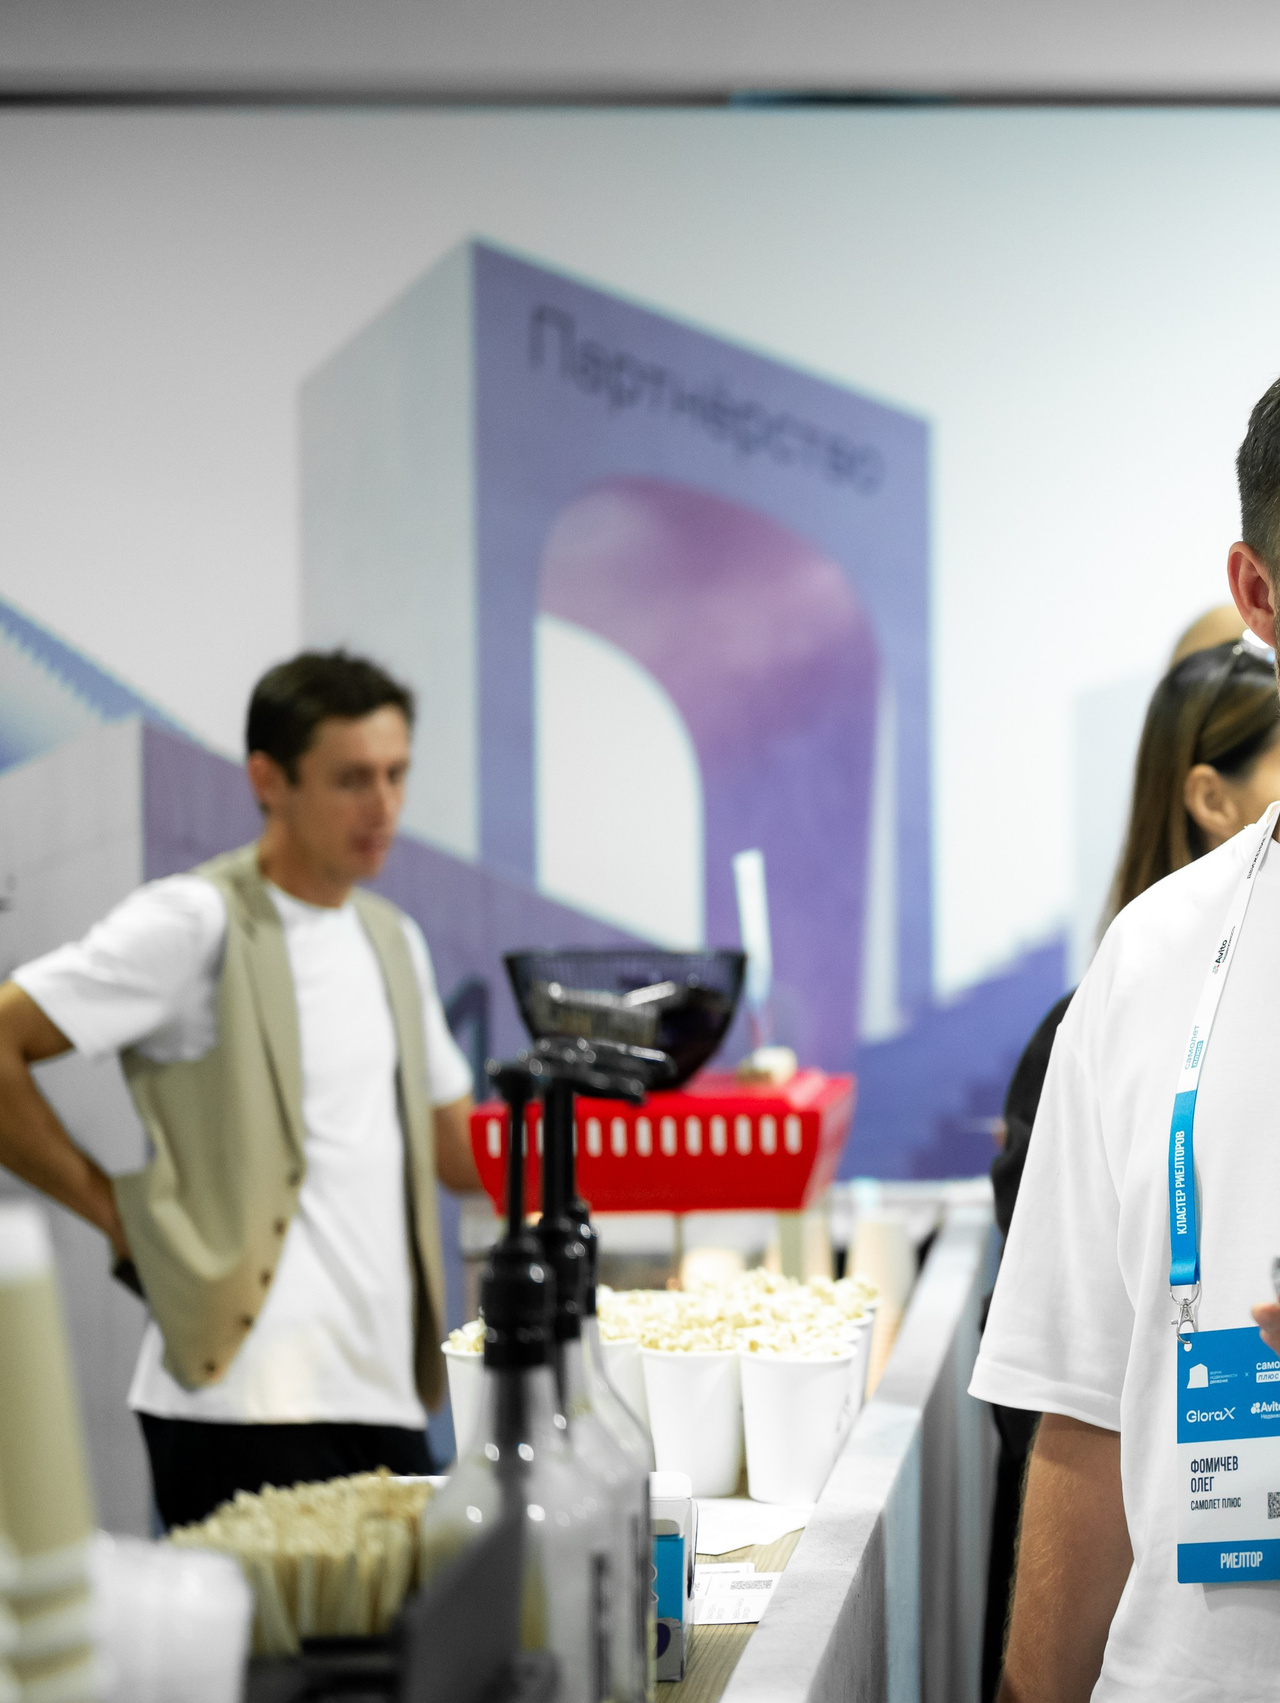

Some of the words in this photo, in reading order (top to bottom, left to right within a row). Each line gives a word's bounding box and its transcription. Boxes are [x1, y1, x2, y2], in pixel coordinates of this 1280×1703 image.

[1215, 939, 1228, 964] Avito
[1175, 1130, 1186, 1188] РИЕЛТОРОВ
[1176, 1189, 1187, 1234] КЛАСТЕР
[1186, 1407, 1236, 1423] GloraX
[1190, 1455, 1239, 1474] ФОМИЧЕВ
[1190, 1476, 1215, 1493] ОЛЕГ
[1190, 1498, 1220, 1511] САМОЛЕТ
[1221, 1497, 1242, 1508] ПЛЮС
[1220, 1551, 1263, 1569] РИЕЛТОР
